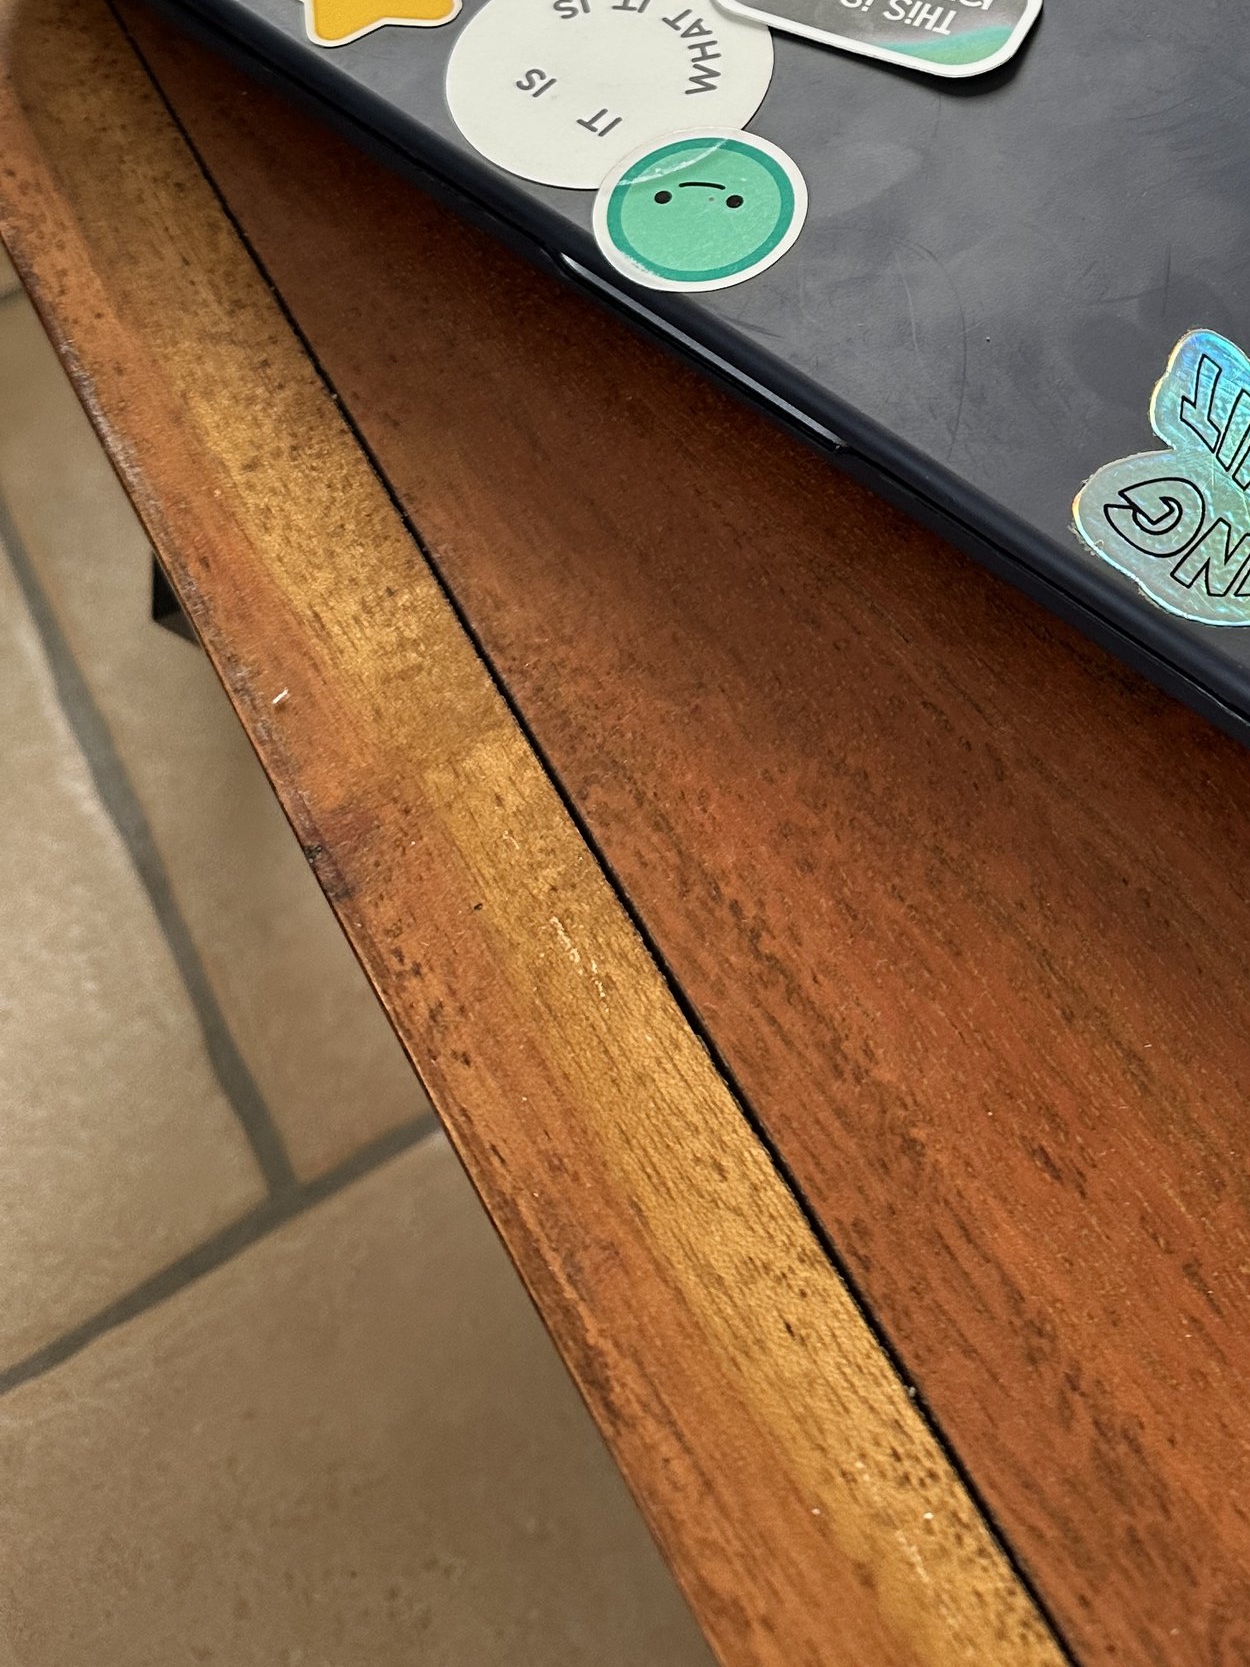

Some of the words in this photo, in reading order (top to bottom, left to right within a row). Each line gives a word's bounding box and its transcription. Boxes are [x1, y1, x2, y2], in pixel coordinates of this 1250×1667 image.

[662, 9, 721, 95] WHAT
[515, 68, 557, 98] IS
[576, 108, 622, 137] IT
